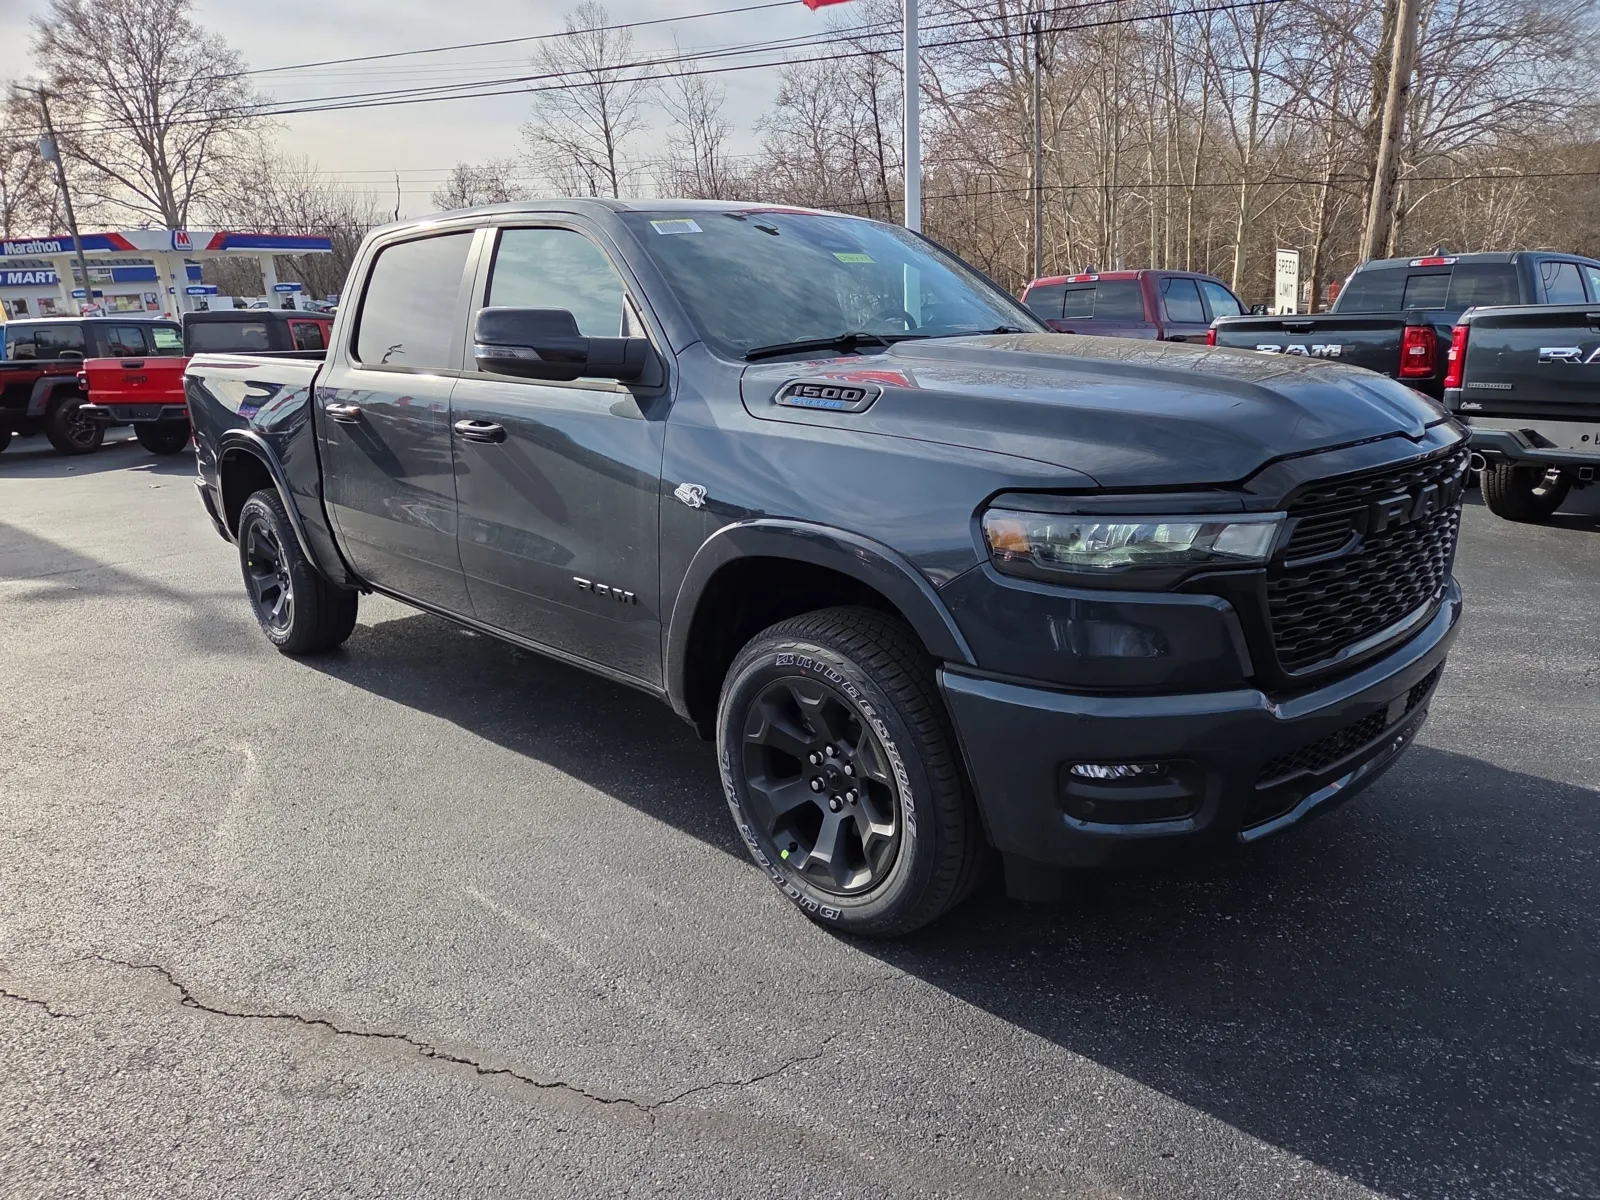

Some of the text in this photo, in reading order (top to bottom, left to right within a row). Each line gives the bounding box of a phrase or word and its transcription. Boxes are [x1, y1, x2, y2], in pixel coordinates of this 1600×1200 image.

[4, 240, 61, 255] Marathon
[1278, 258, 1296, 275] SPEED
[7, 271, 56, 285] MART
[1279, 281, 1293, 298] LIMIT
[1256, 344, 1342, 357] RAM
[794, 385, 861, 401] 1500
[1366, 470, 1462, 534] RAM
[573, 576, 637, 606] RAM
[775, 653, 918, 838] BRIDGESTONE
[741, 824, 841, 920] DUELER
